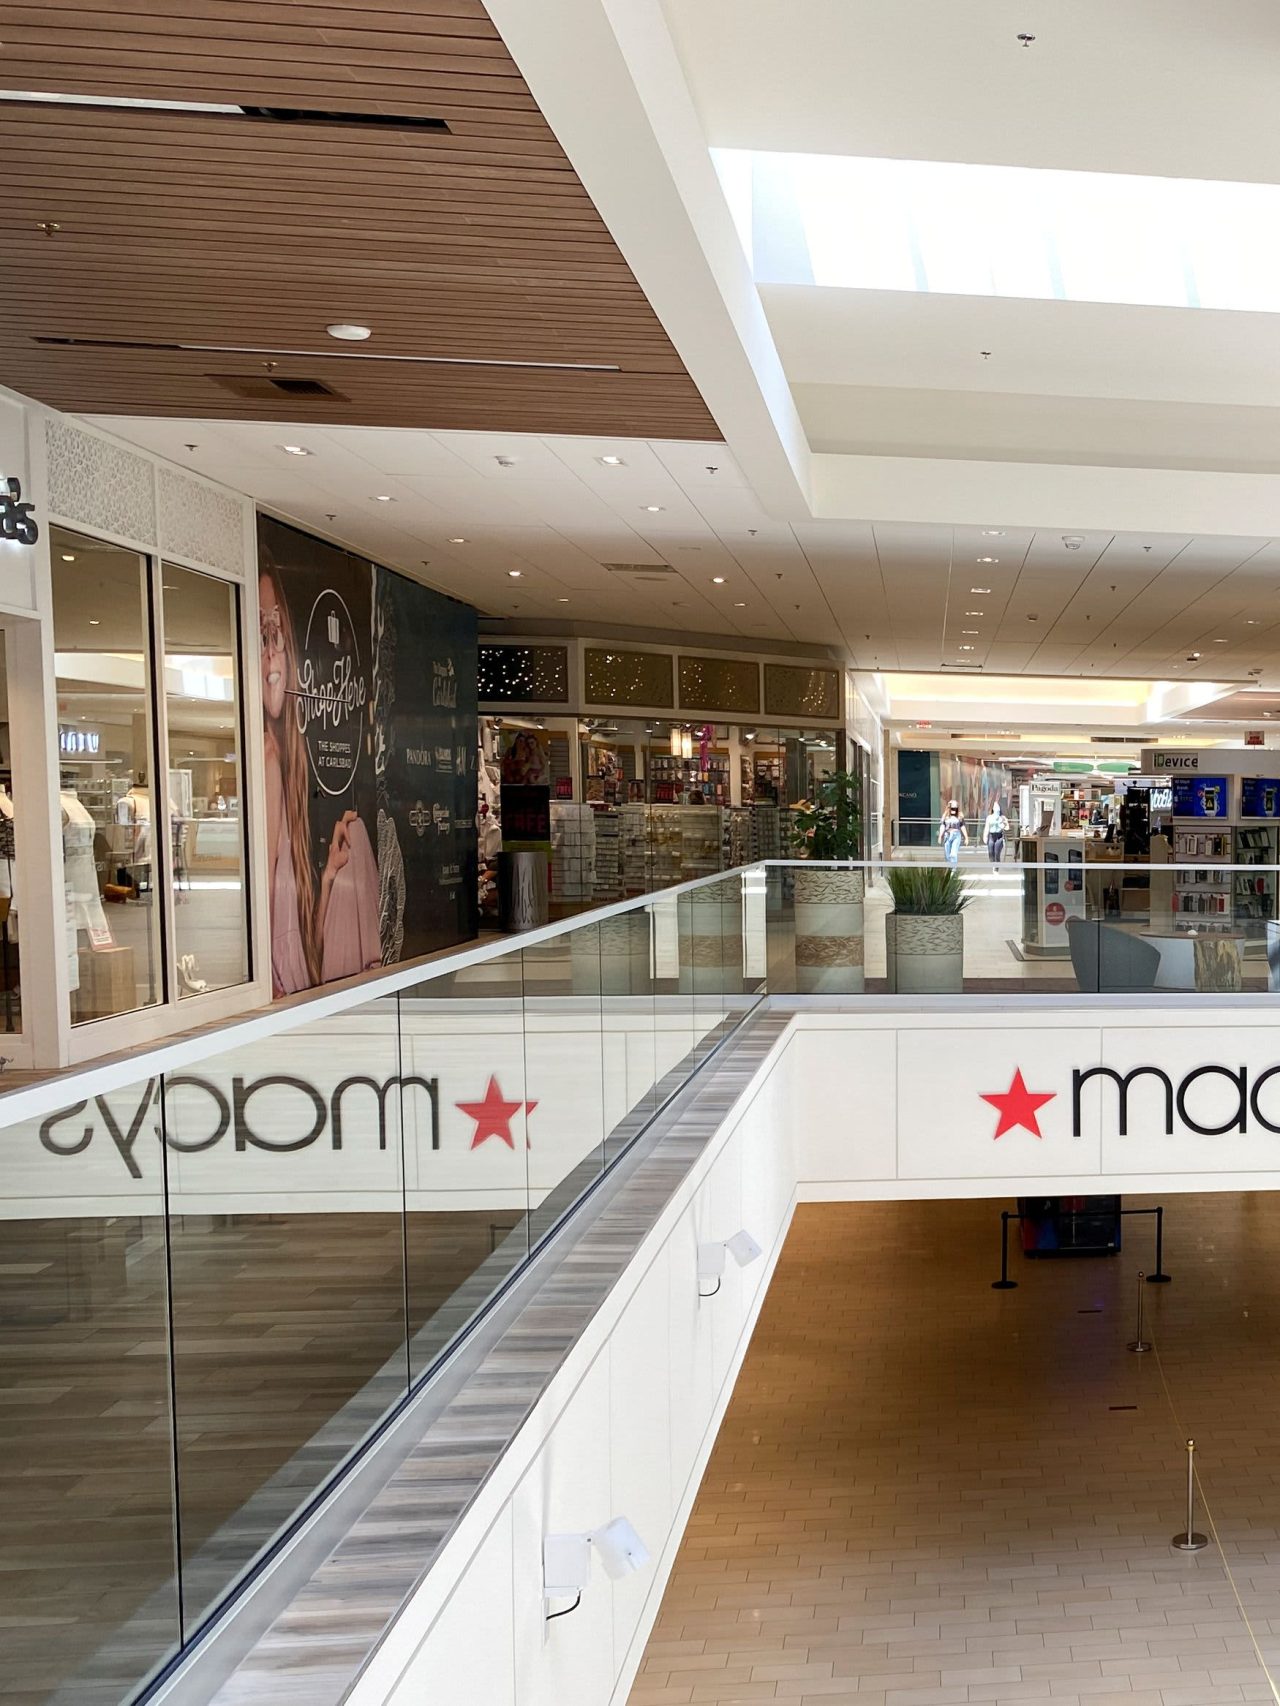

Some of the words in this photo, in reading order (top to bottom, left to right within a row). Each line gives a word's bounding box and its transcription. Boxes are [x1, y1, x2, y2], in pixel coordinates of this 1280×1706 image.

[296, 659, 333, 734] Shop
[332, 655, 366, 727] Here
[1031, 783, 1059, 793] Pagoda
